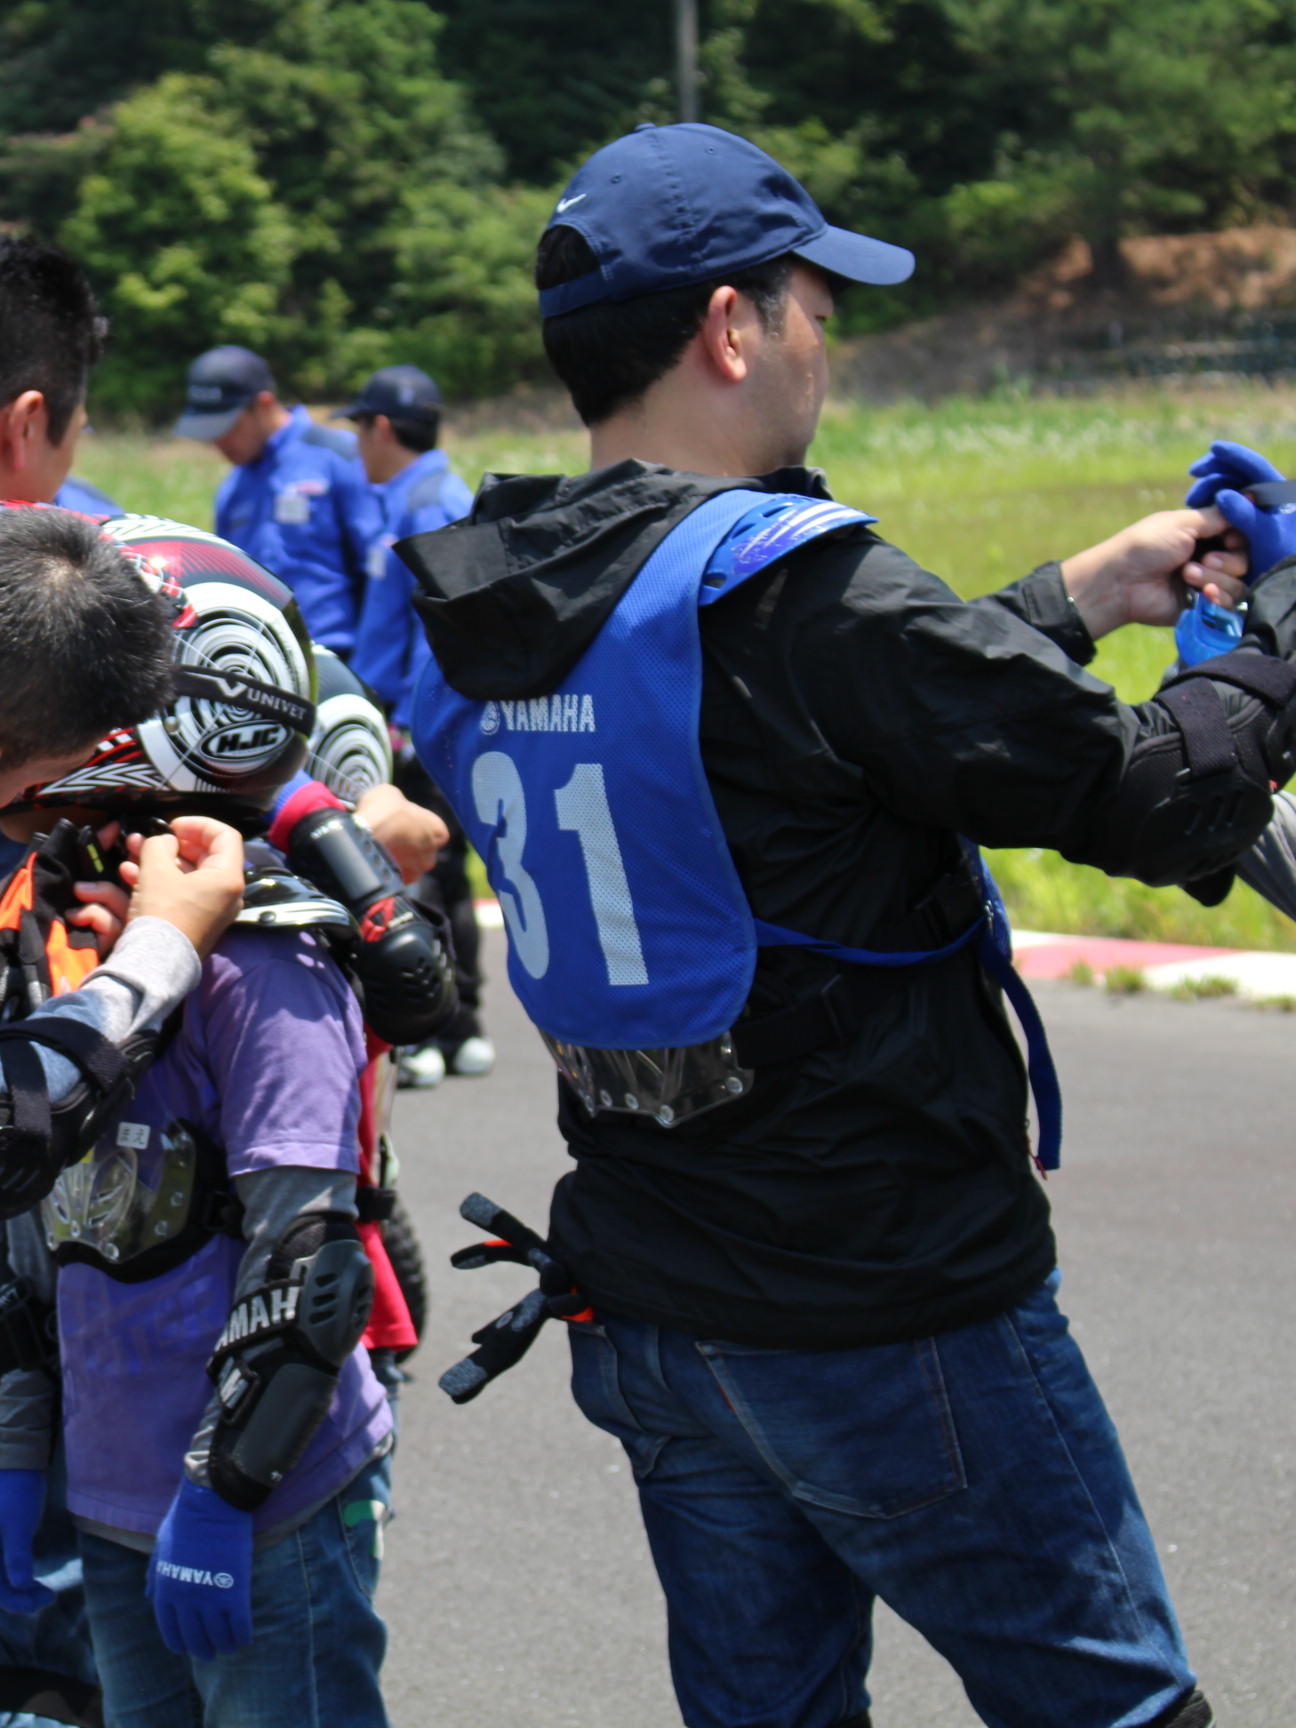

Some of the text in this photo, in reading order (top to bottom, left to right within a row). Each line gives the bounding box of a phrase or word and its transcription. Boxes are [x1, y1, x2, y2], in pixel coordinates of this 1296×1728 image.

[246, 687, 306, 720] UNIVET
[501, 694, 596, 733] YAMAHA
[215, 725, 282, 754] HJC
[472, 751, 649, 986] 31
